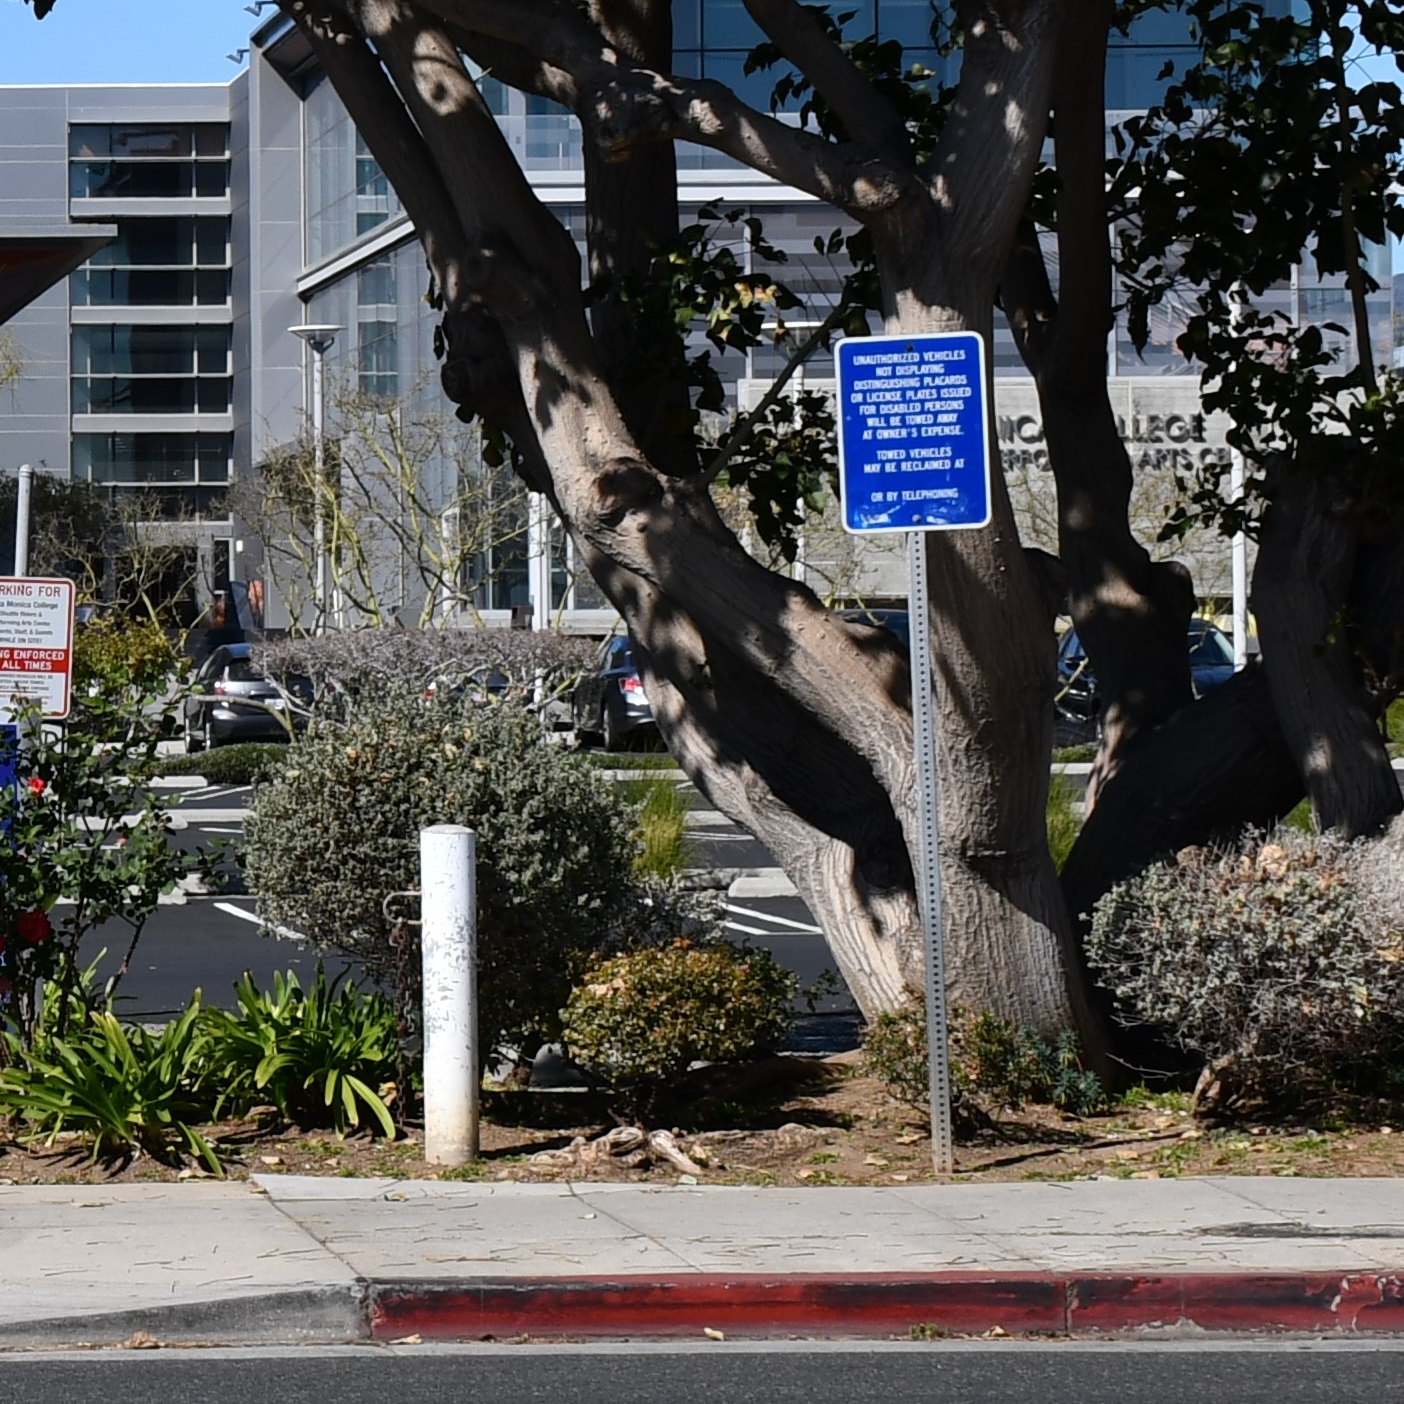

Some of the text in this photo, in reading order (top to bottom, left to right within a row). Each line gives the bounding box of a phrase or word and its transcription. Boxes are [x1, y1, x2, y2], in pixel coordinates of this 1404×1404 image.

[853, 350, 965, 365] UNAUTHORIZED VEHICLES
[876, 364, 944, 376] NOT DISPLAYING
[854, 376, 967, 390] DISTINGUISHING PLACARDS
[851, 388, 971, 403] OR LICENSE PLATES ISSUED
[860, 401, 964, 415] FOR DISABLED PERSONS
[867, 413, 958, 427] WILL BE TOWED AWAY
[863, 426, 964, 440] AT OWNER'S EXPENSE.
[1118, 415, 1205, 443] LLEGE
[877, 447, 952, 460] TOWED VEHICLES
[864, 458, 964, 473] MAY BE RECLAIMED AT
[871, 488, 958, 502] OR BY TELEPHONING
[38, 586, 61, 597] FOR
[33, 601, 58, 609] College
[14, 650, 65, 660] ENFORCED
[2, 661, 21, 669] ALL
[25, 661, 52, 670] TIMES
